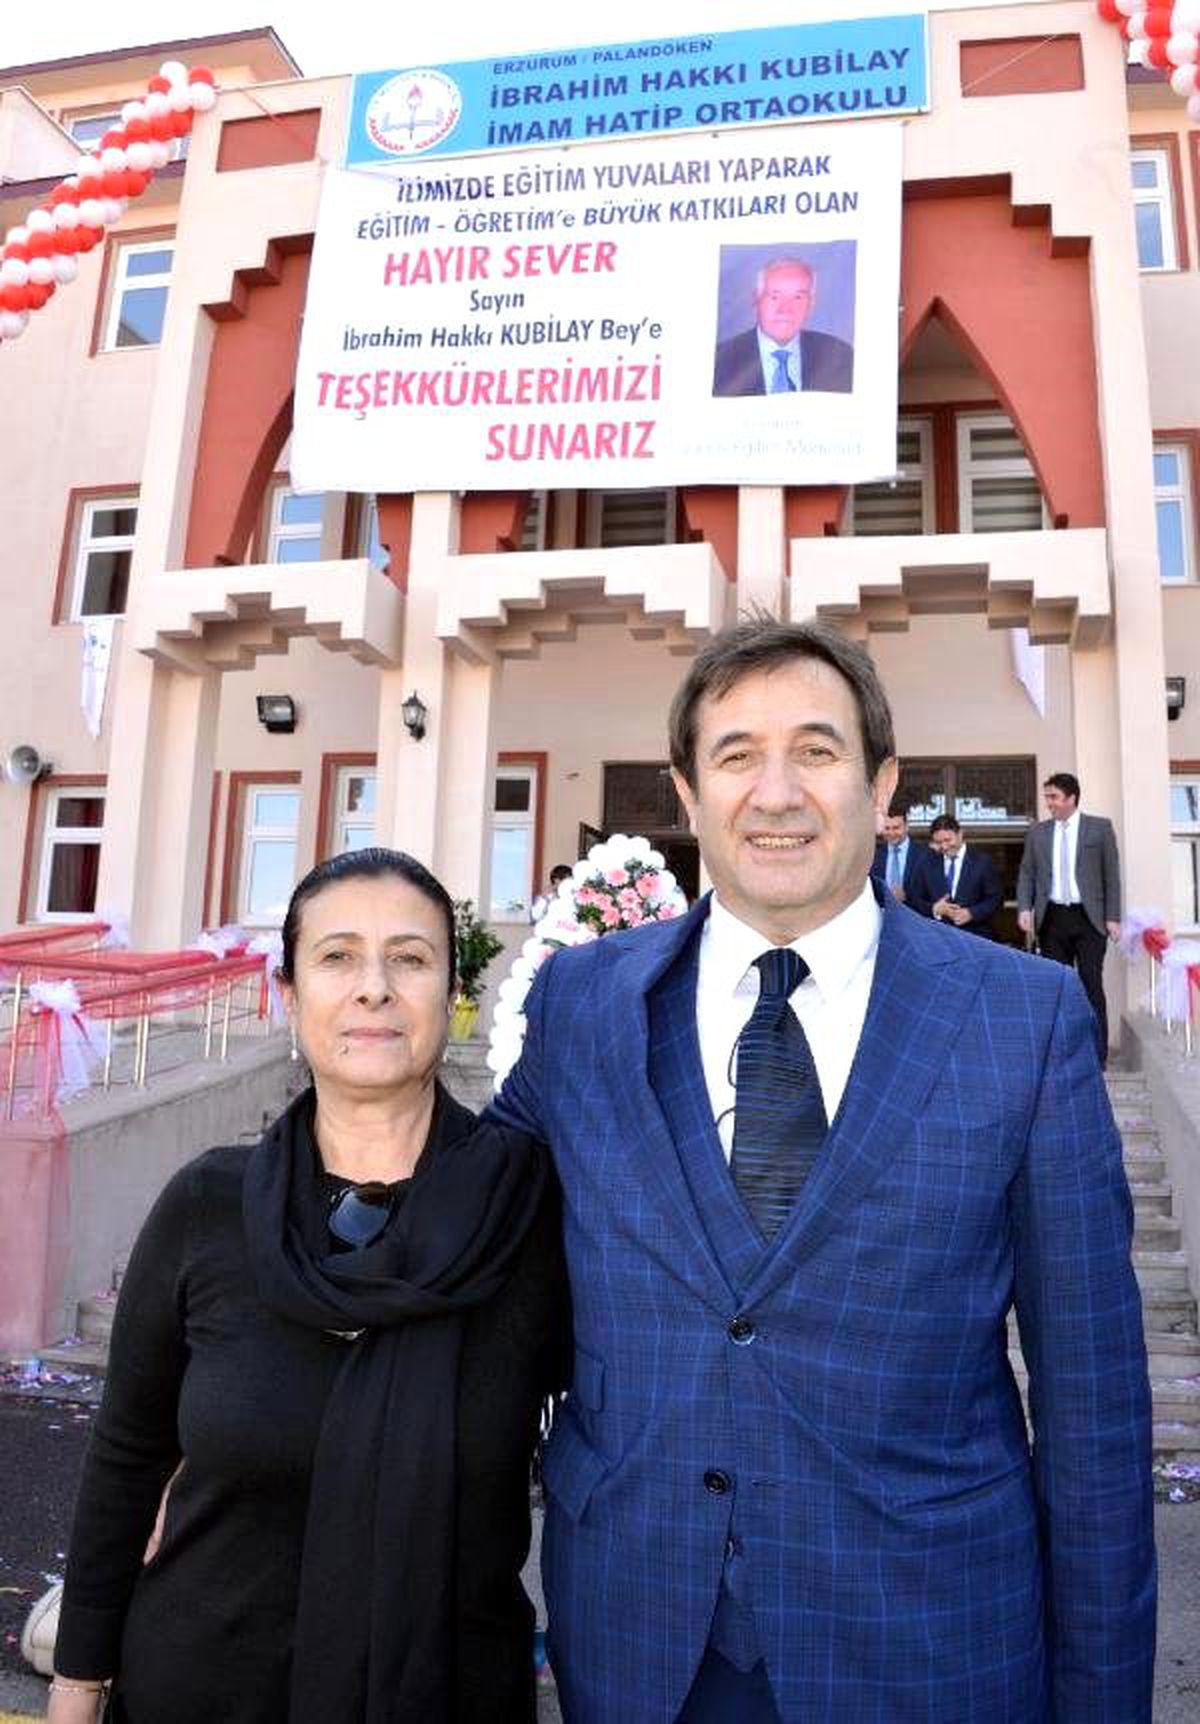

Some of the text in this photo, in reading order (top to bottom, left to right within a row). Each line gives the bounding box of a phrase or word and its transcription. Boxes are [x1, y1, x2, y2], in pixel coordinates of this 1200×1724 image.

[490, 73, 628, 109] İBRAHİM
[641, 63, 747, 93] HAKKI
[760, 48, 910, 81] KUBİLAY
[493, 54, 577, 75] ERZURUM
[487, 117, 573, 145] İMAM
[585, 103, 683, 136] HATİP
[695, 85, 907, 125] ORTAOKULU
[397, 154, 832, 203] İLİMİZDE EĞİTİM YUVALARI YAPARAK
[357, 208, 431, 240] EĞİTİM
[583, 198, 662, 226] BÜYÜK
[669, 194, 786, 222] KATKILARI
[795, 191, 859, 215] OLAN
[383, 241, 618, 287] HAYIR SEVER
[469, 288, 525, 316] Sayın
[342, 324, 423, 352] İbrahim
[430, 323, 493, 348] Hakkı
[500, 313, 595, 346] KUBİLAY
[316, 354, 662, 421] TEŞEKKÜRLERİMİZİ
[485, 419, 657, 462] SUNARIZ
